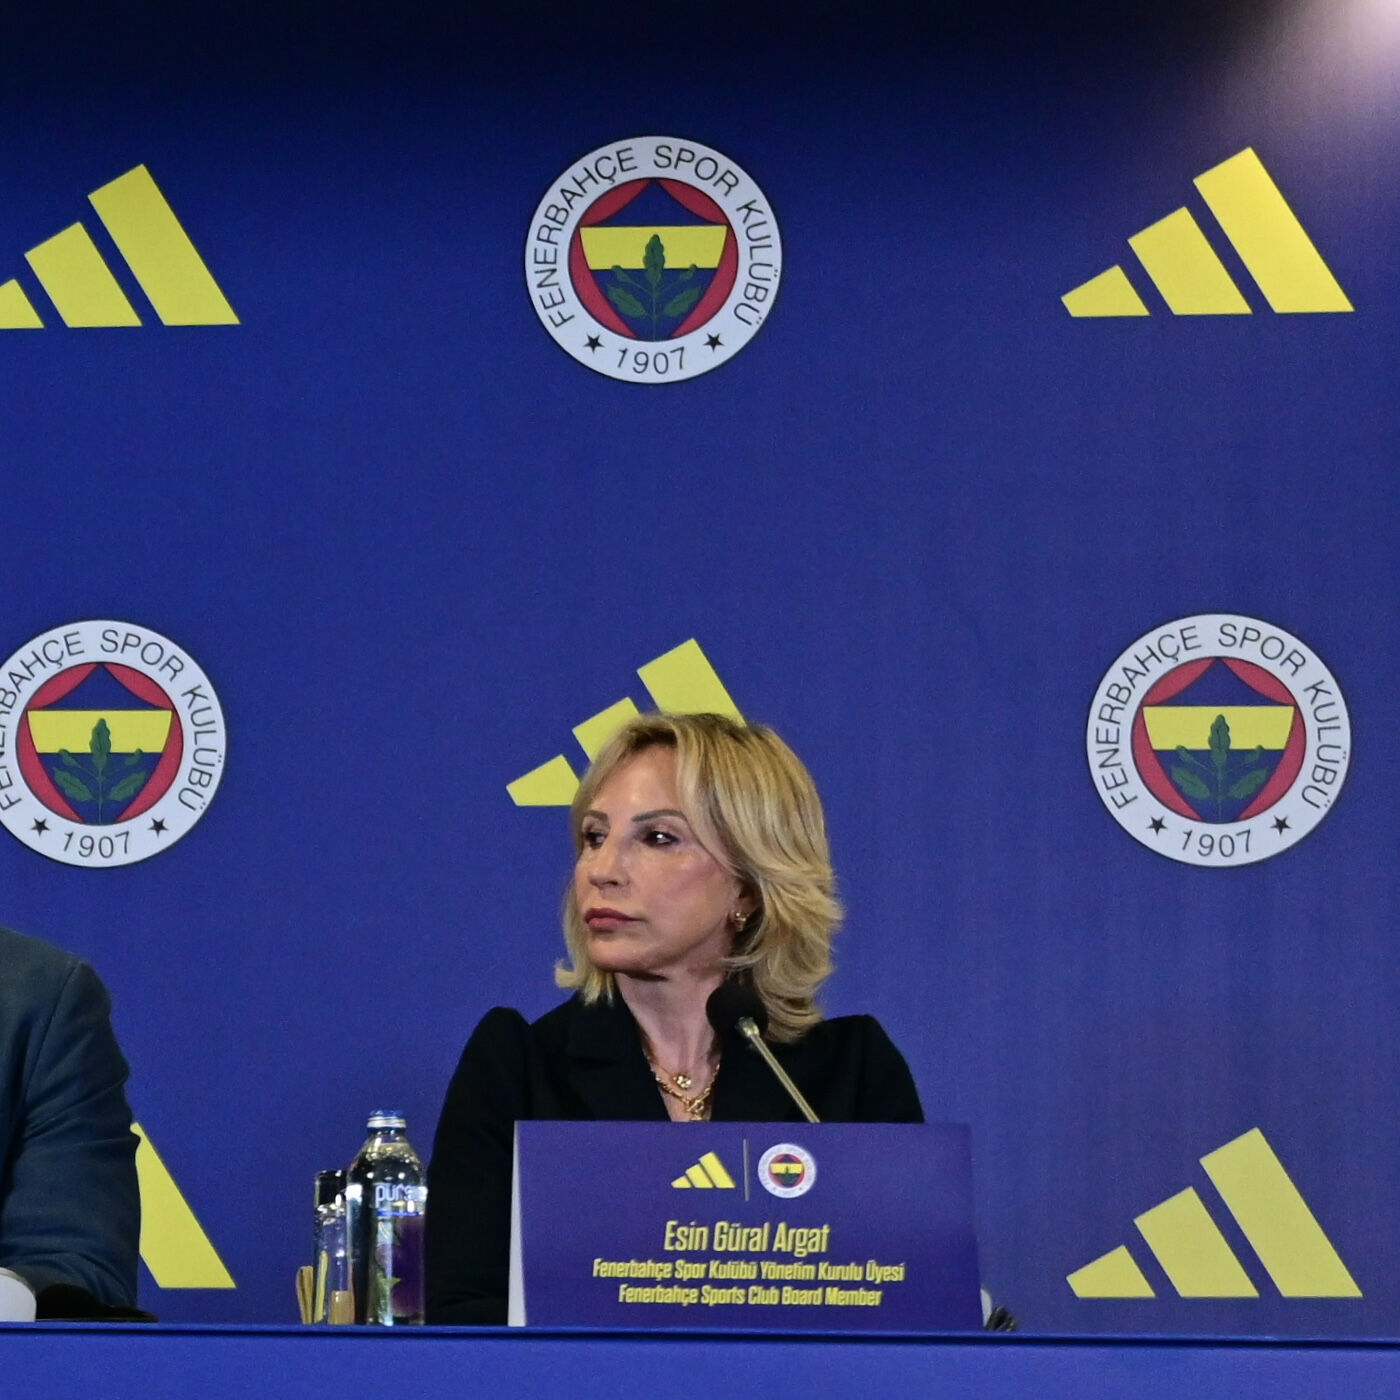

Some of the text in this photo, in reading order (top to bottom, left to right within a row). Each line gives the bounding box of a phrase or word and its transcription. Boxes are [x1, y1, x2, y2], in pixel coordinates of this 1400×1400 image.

[534, 145, 778, 328] FENERBAHÇE SPOR KULÜBÜ
[616, 346, 685, 374] 1907
[100, 629, 185, 682] SPOR
[178, 685, 223, 811] KULÜBÜ
[1096, 623, 1347, 809] FENERBAHÇE SPOR KULÜBÜ
[63, 831, 130, 858] 1907
[1181, 830, 1252, 857] 1907
[664, 1220, 830, 1257] Esin Güral Argat
[593, 1258, 905, 1284] Fenerbahçe Spor Kulübü Yönetim Kurulu Üyesi
[618, 1284, 883, 1307] Fenerbahçe Sports Club Board Member
